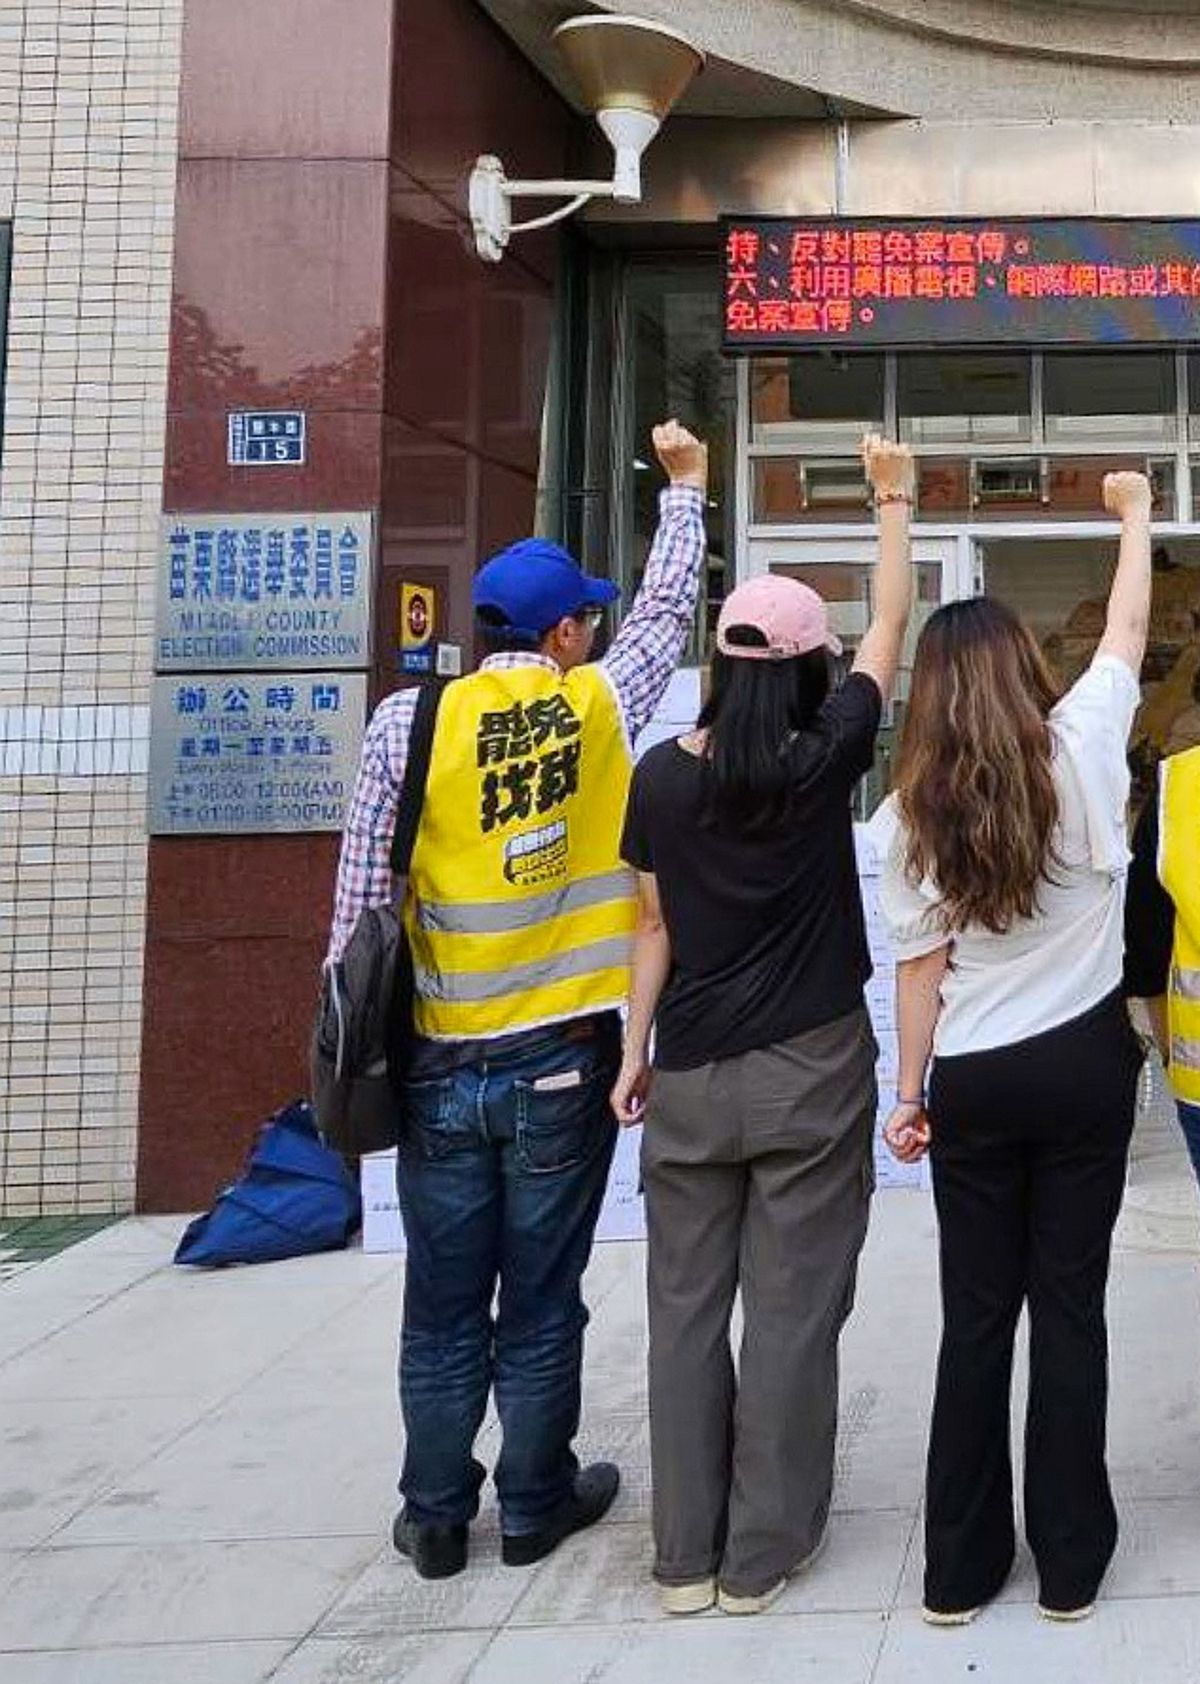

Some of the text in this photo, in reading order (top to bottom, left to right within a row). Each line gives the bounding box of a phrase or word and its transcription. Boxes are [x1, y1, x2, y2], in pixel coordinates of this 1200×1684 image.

[727, 299, 874, 332] 免案宣傳。
[261, 441, 288, 459] 15
[266, 610, 342, 631] COUNTY
[477, 693, 582, 768] 罷免
[480, 740, 582, 833] 找我
